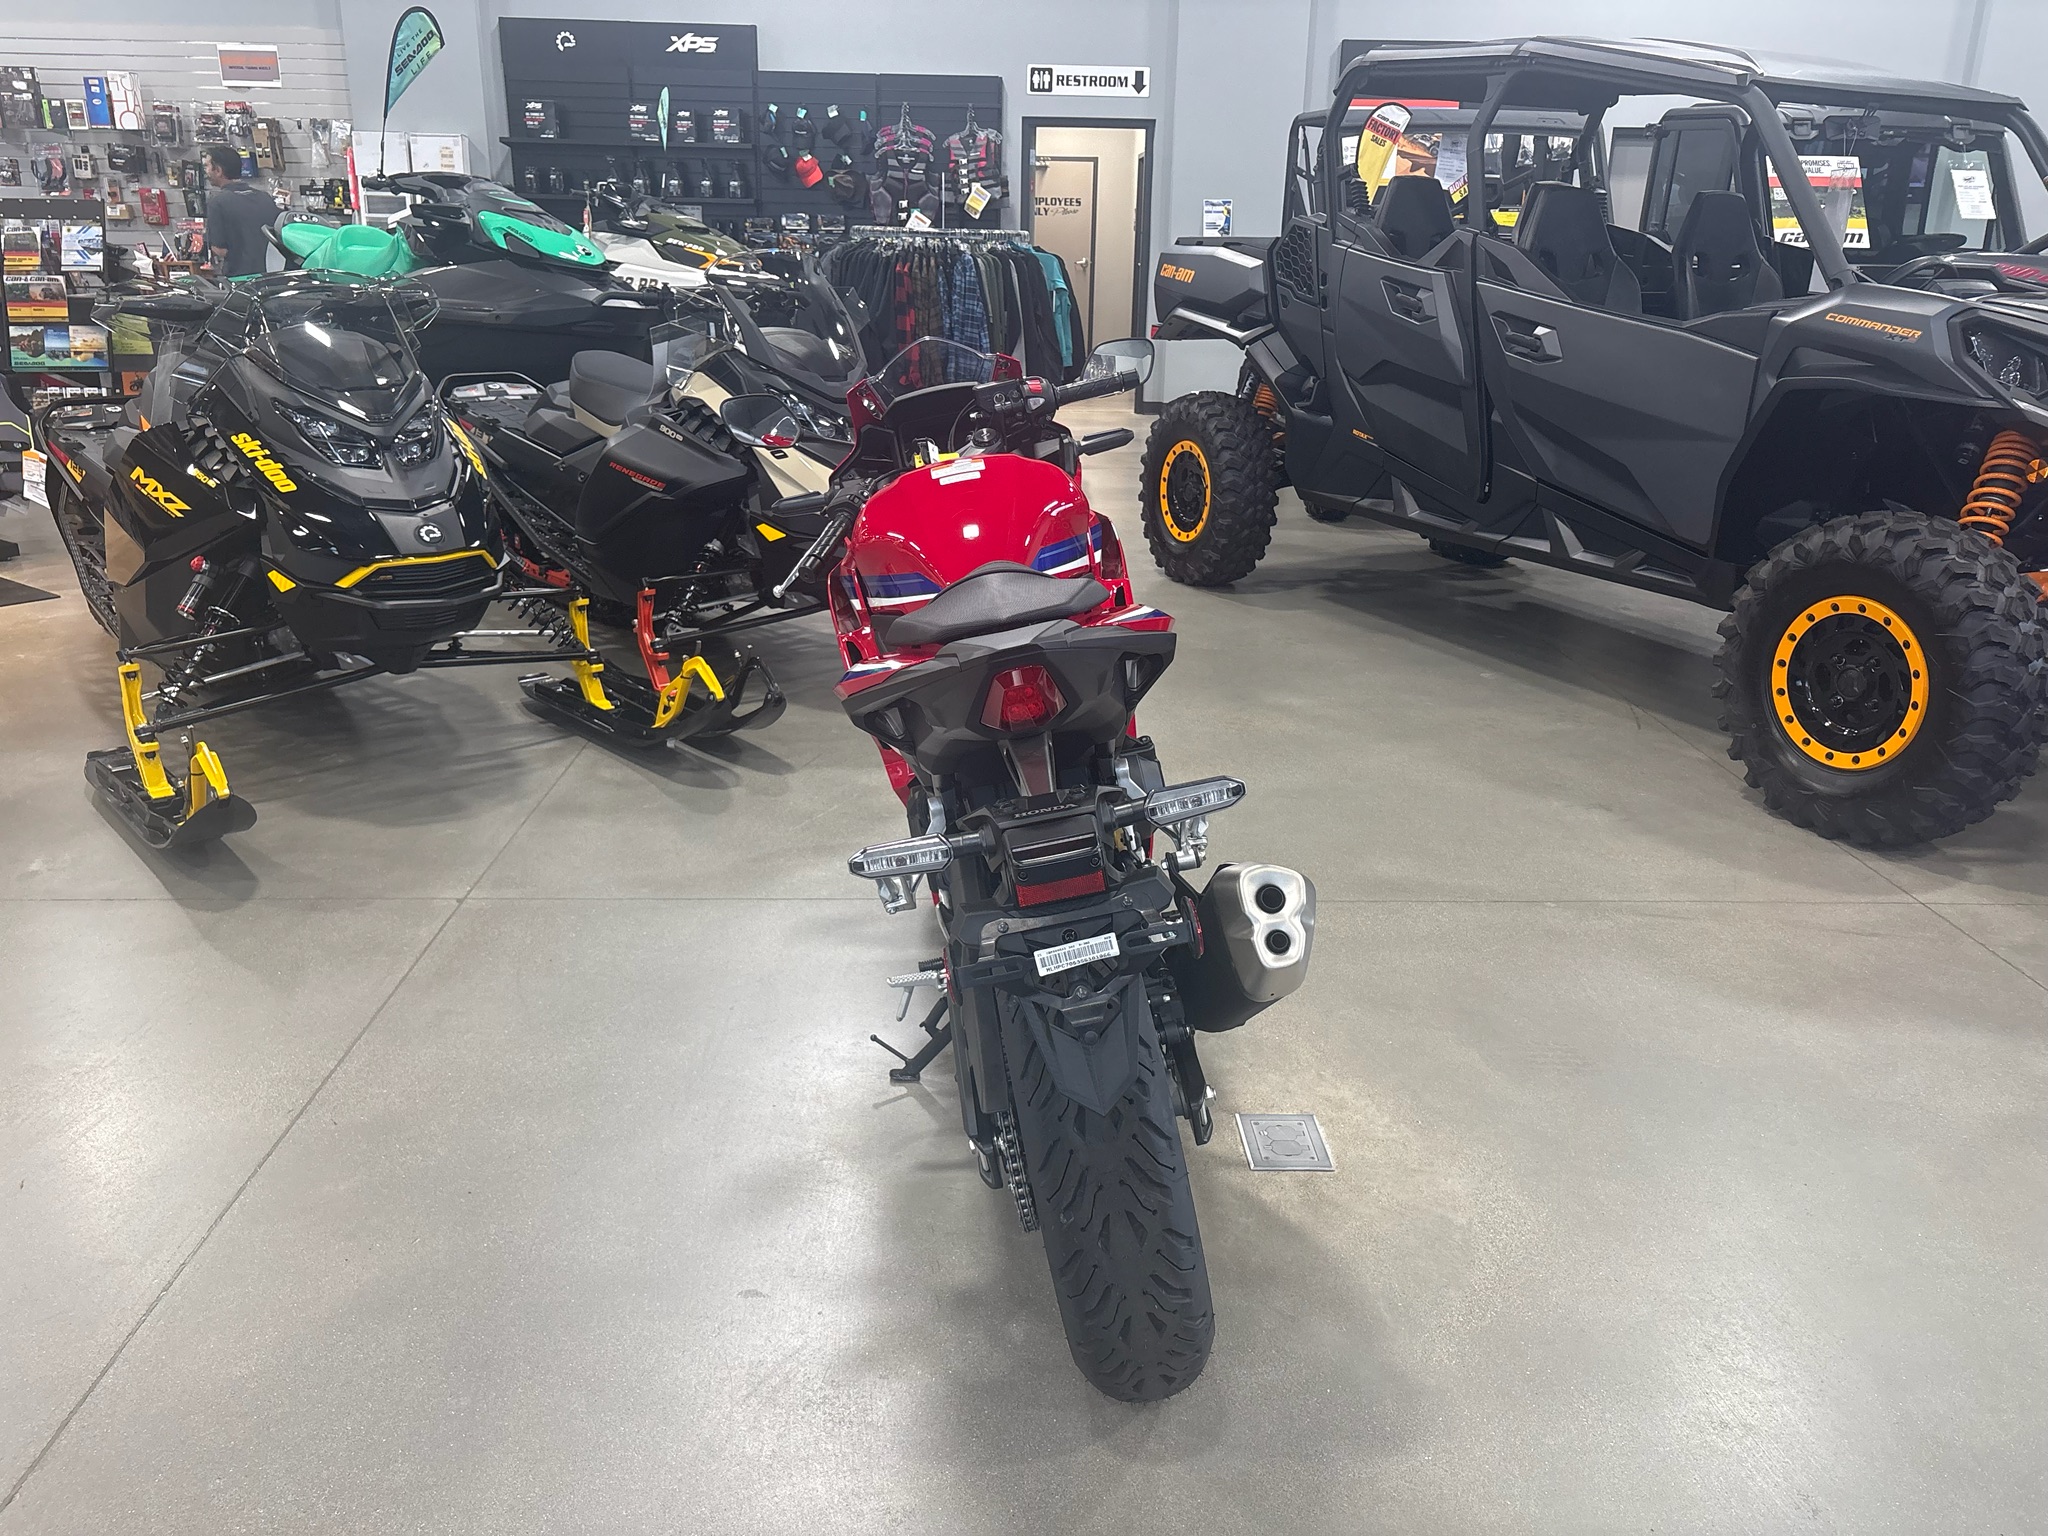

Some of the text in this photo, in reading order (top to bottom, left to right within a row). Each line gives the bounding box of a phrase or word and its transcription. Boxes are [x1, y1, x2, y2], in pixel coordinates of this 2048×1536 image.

[396, 28, 423, 58] LIVE THE
[665, 32, 720, 53] XPS
[410, 50, 431, 75] LIFE
[1056, 74, 1128, 88] RESTROOM
[1367, 118, 1400, 143] FACTORY
[1370, 134, 1387, 147] SALES
[1825, 312, 1923, 338] COMMANDER
[659, 424, 676, 439] 900
[608, 461, 667, 489] RENEGADE
[129, 465, 192, 518] MXZ
[1014, 803, 1079, 819] HONDA
